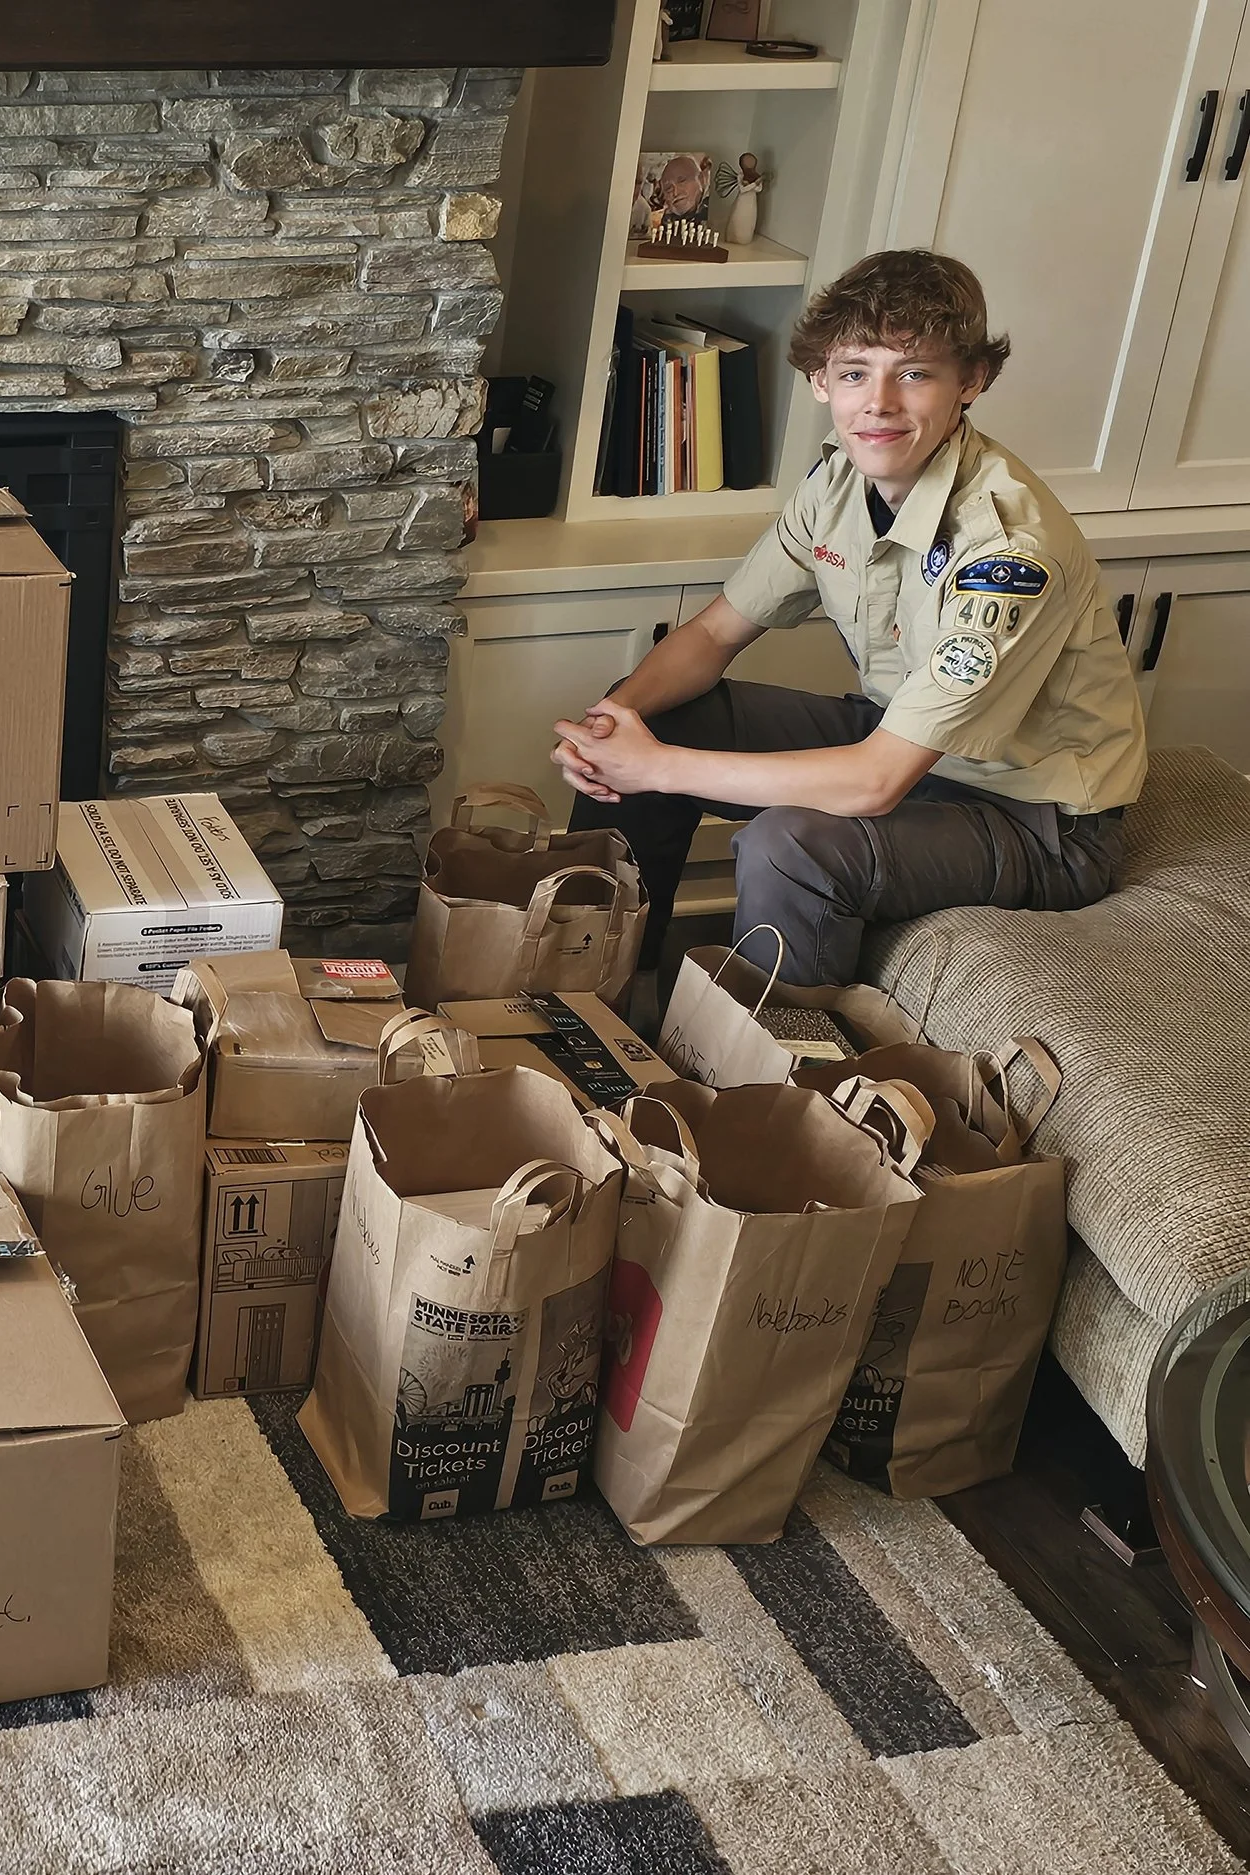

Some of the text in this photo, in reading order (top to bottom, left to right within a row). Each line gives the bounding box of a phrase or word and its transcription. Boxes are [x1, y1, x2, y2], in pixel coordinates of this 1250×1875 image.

[825, 552, 846, 570] BSA
[958, 597, 1020, 632] 409
[961, 636, 986, 651] PATROL
[85, 804, 102, 822] SOLD
[93, 820, 108, 831] AS
[100, 835, 116, 850] SET,
[181, 828, 199, 843] NOT
[108, 849, 122, 859] DO
[191, 842, 206, 853] DO
[113, 859, 131, 874] NOT
[197, 852, 214, 867] SET,
[209, 872, 223, 883] AS
[214, 881, 235, 900] SOLD
[80, 1165, 161, 1218] Glue
[954, 1249, 1025, 1288] NOTE
[415, 1297, 512, 1325] MINNESOTA
[746, 1292, 849, 1334] Notebooks
[942, 1289, 1020, 1325] BOOKS
[413, 1310, 466, 1335] STATE
[469, 1322, 512, 1336] FAIR
[396, 1438, 501, 1459] Discount
[403, 1457, 487, 1479] Tickets
[538, 1465, 553, 1475] on
[415, 1474, 470, 1490] on sale at
